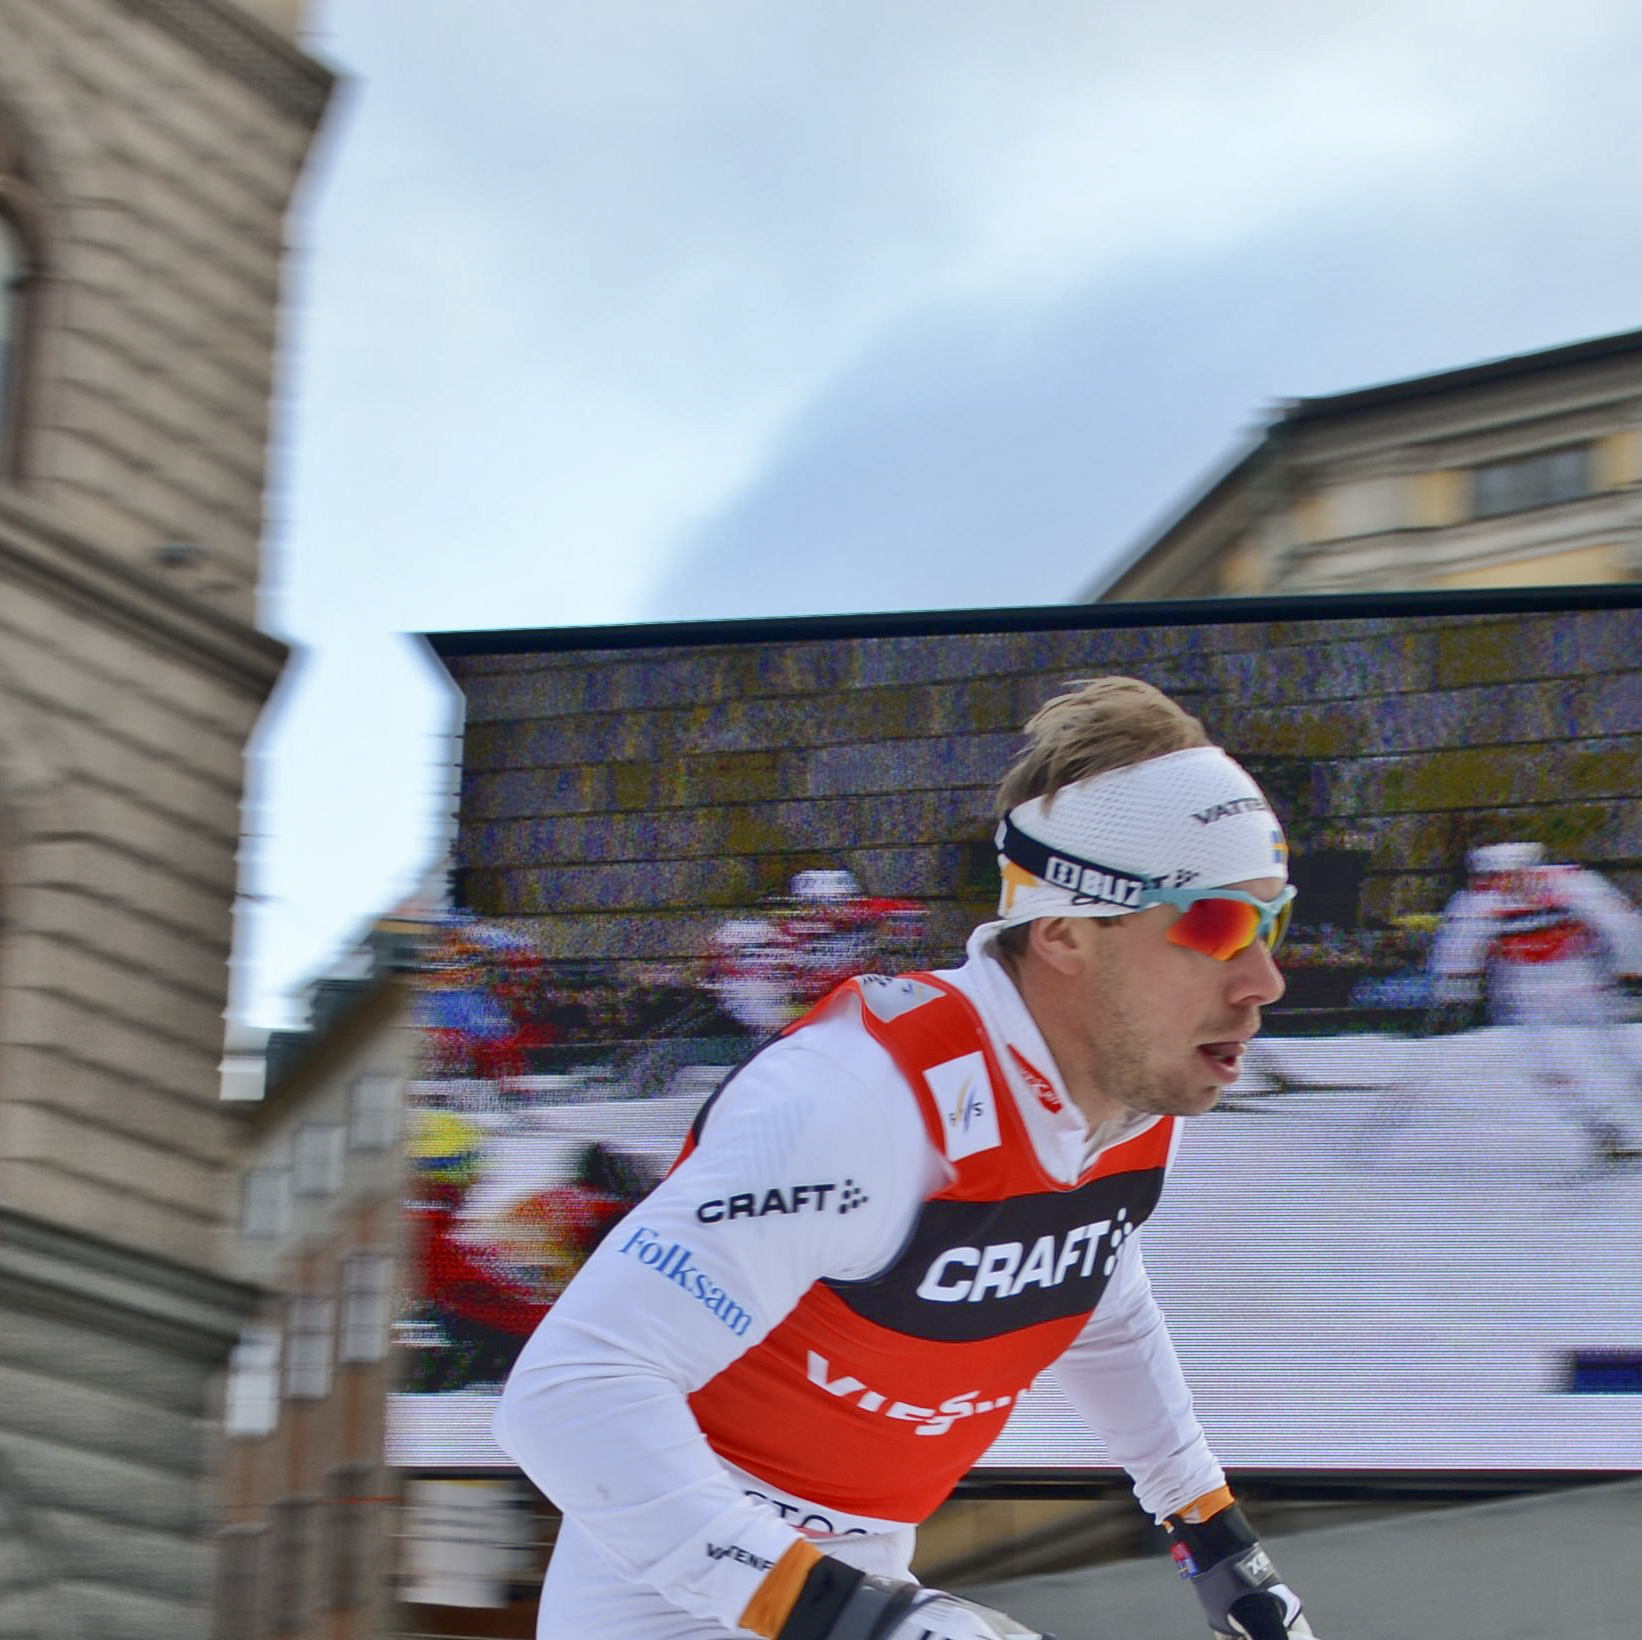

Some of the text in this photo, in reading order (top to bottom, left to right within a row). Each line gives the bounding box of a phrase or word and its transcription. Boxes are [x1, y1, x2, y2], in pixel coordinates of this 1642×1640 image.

[697, 1184, 835, 1224] CRAFT
[618, 1225, 753, 1338] Folksam
[918, 1219, 1112, 1302] CRAFT
